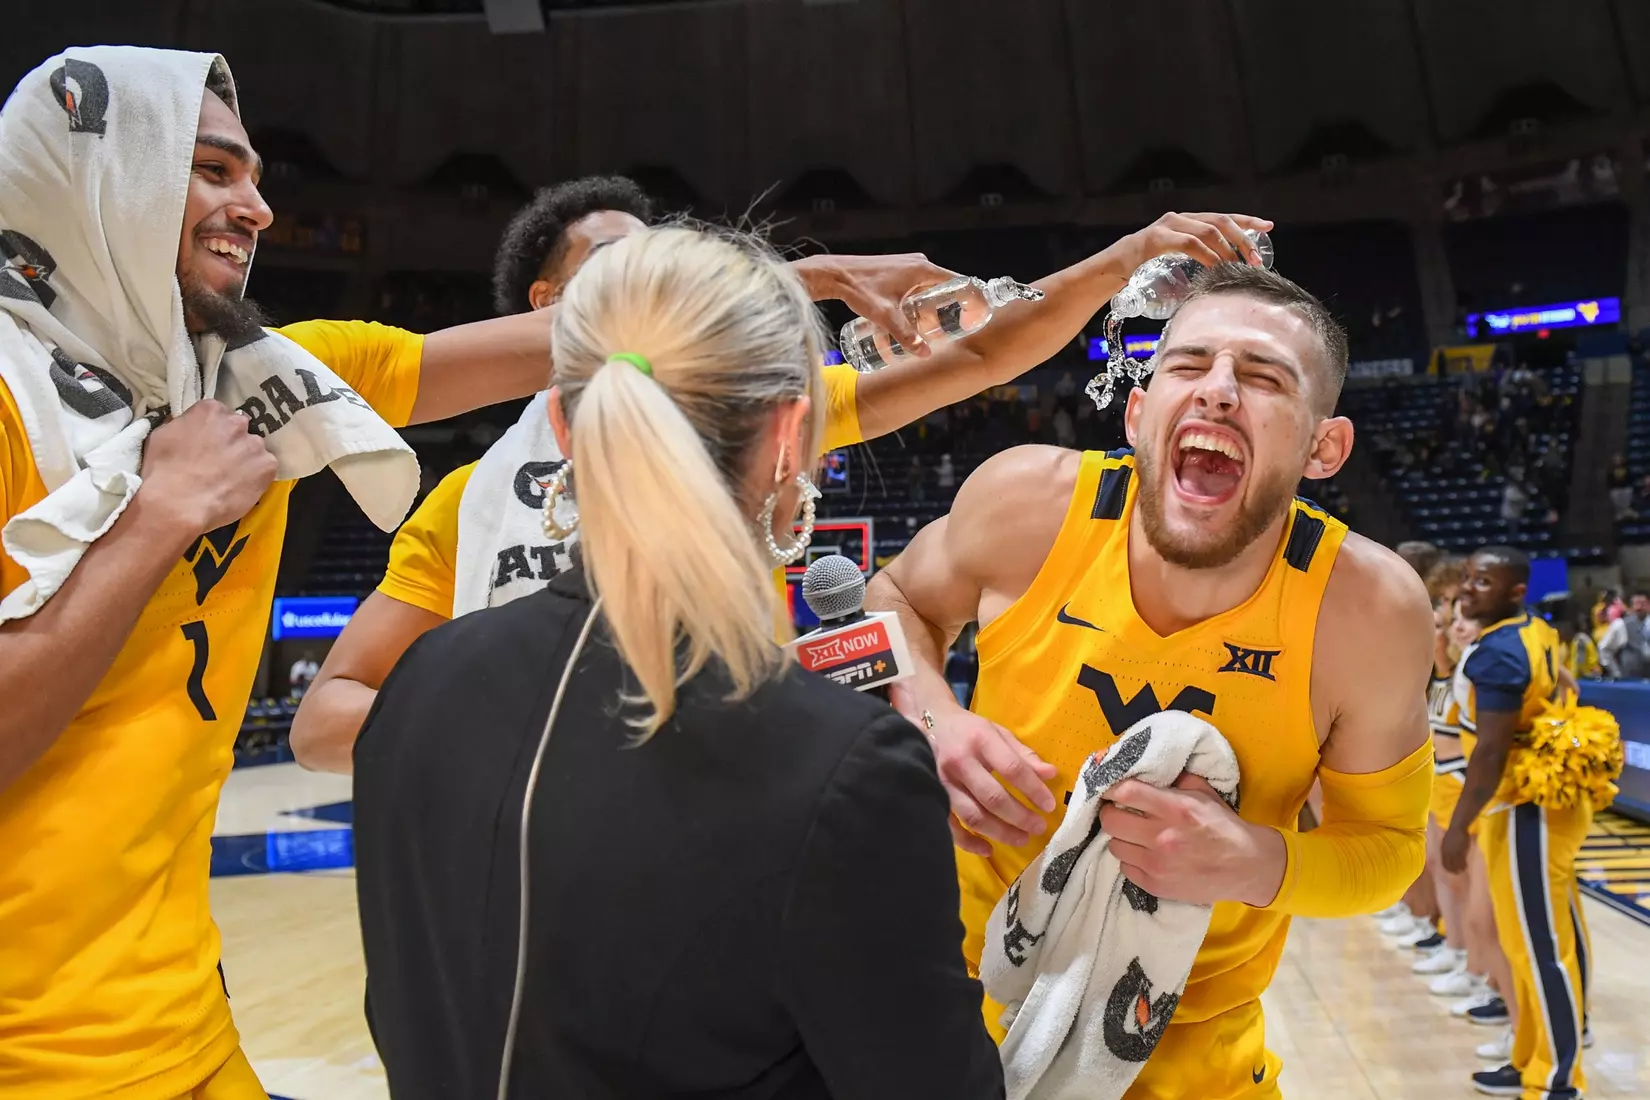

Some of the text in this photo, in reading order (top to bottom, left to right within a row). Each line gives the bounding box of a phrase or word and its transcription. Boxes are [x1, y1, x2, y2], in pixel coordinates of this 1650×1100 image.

[842, 631, 879, 654] NOW
[1217, 641, 1282, 682] XII
[180, 620, 217, 721] 1
